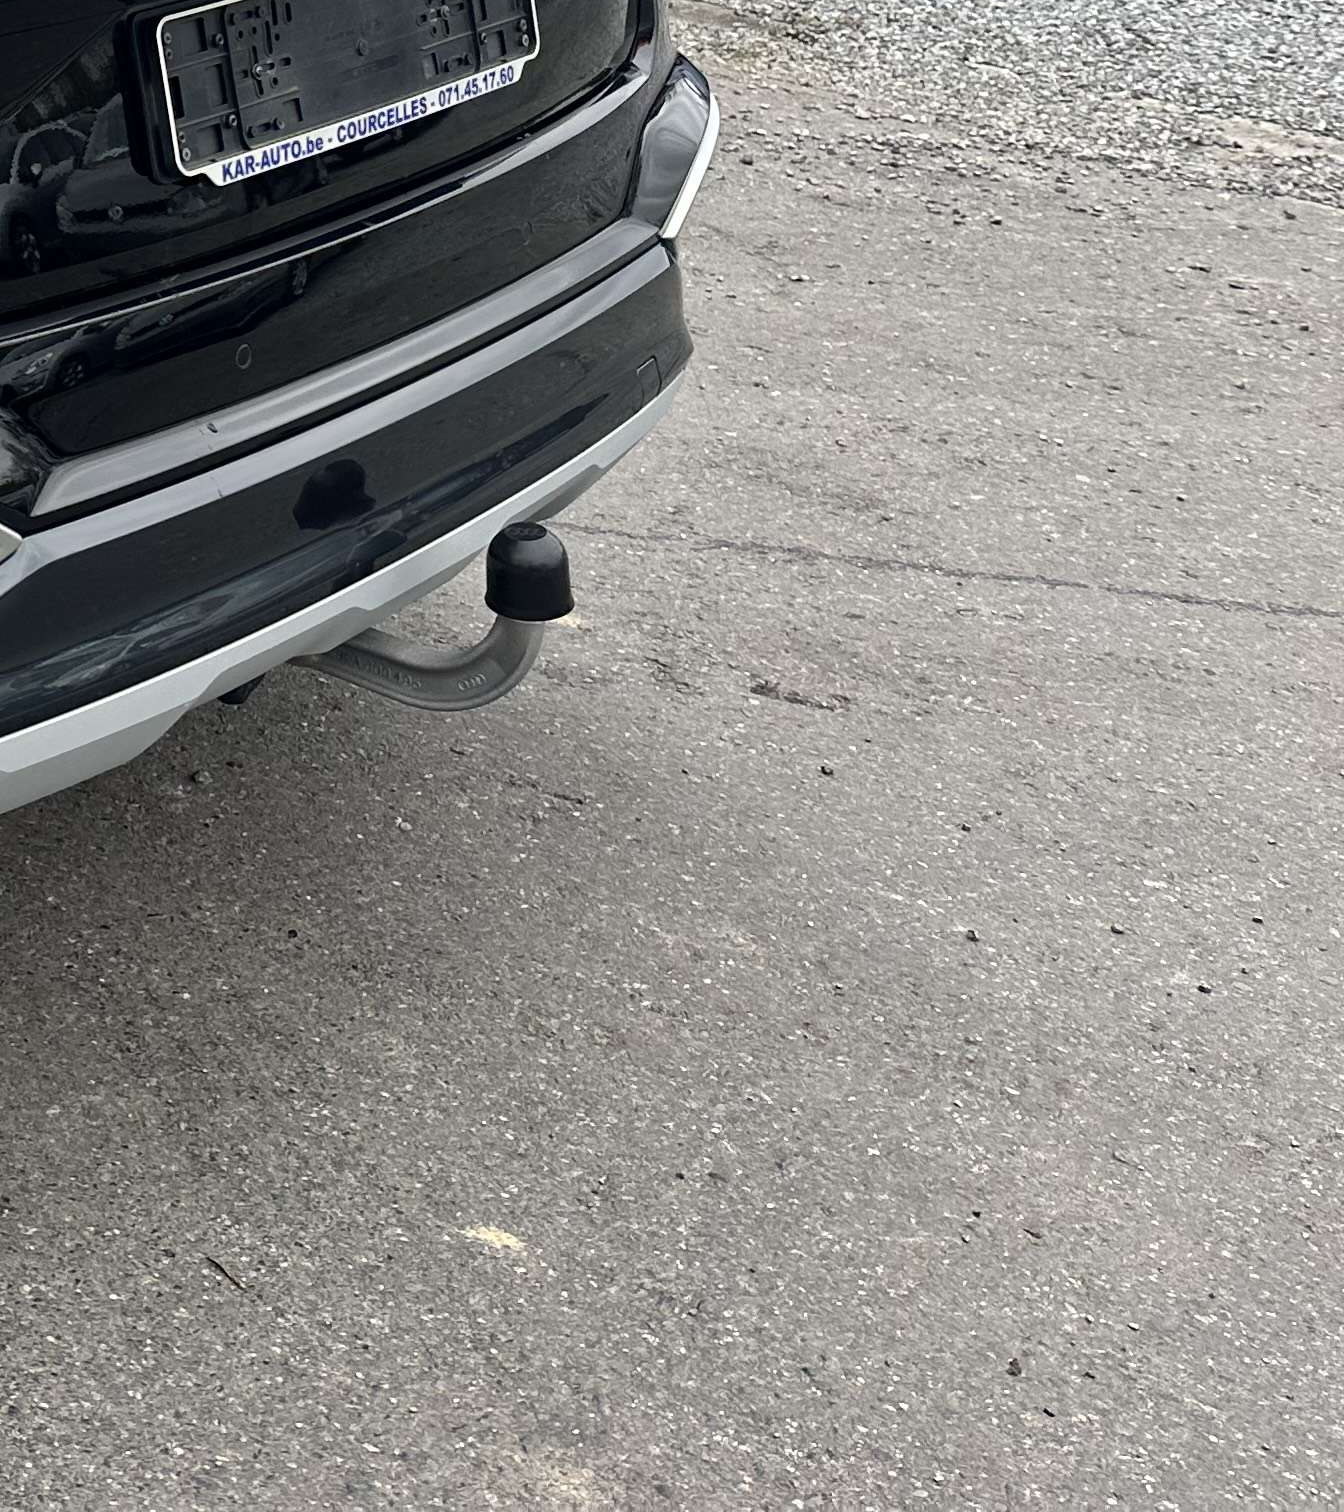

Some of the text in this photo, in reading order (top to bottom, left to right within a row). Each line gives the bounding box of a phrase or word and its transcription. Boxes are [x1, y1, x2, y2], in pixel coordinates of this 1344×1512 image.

[222, 136, 324, 182] KAR-AUTO.be
[337, 96, 427, 143] COURCELLES
[438, 65, 514, 107] 071.45.17.60
